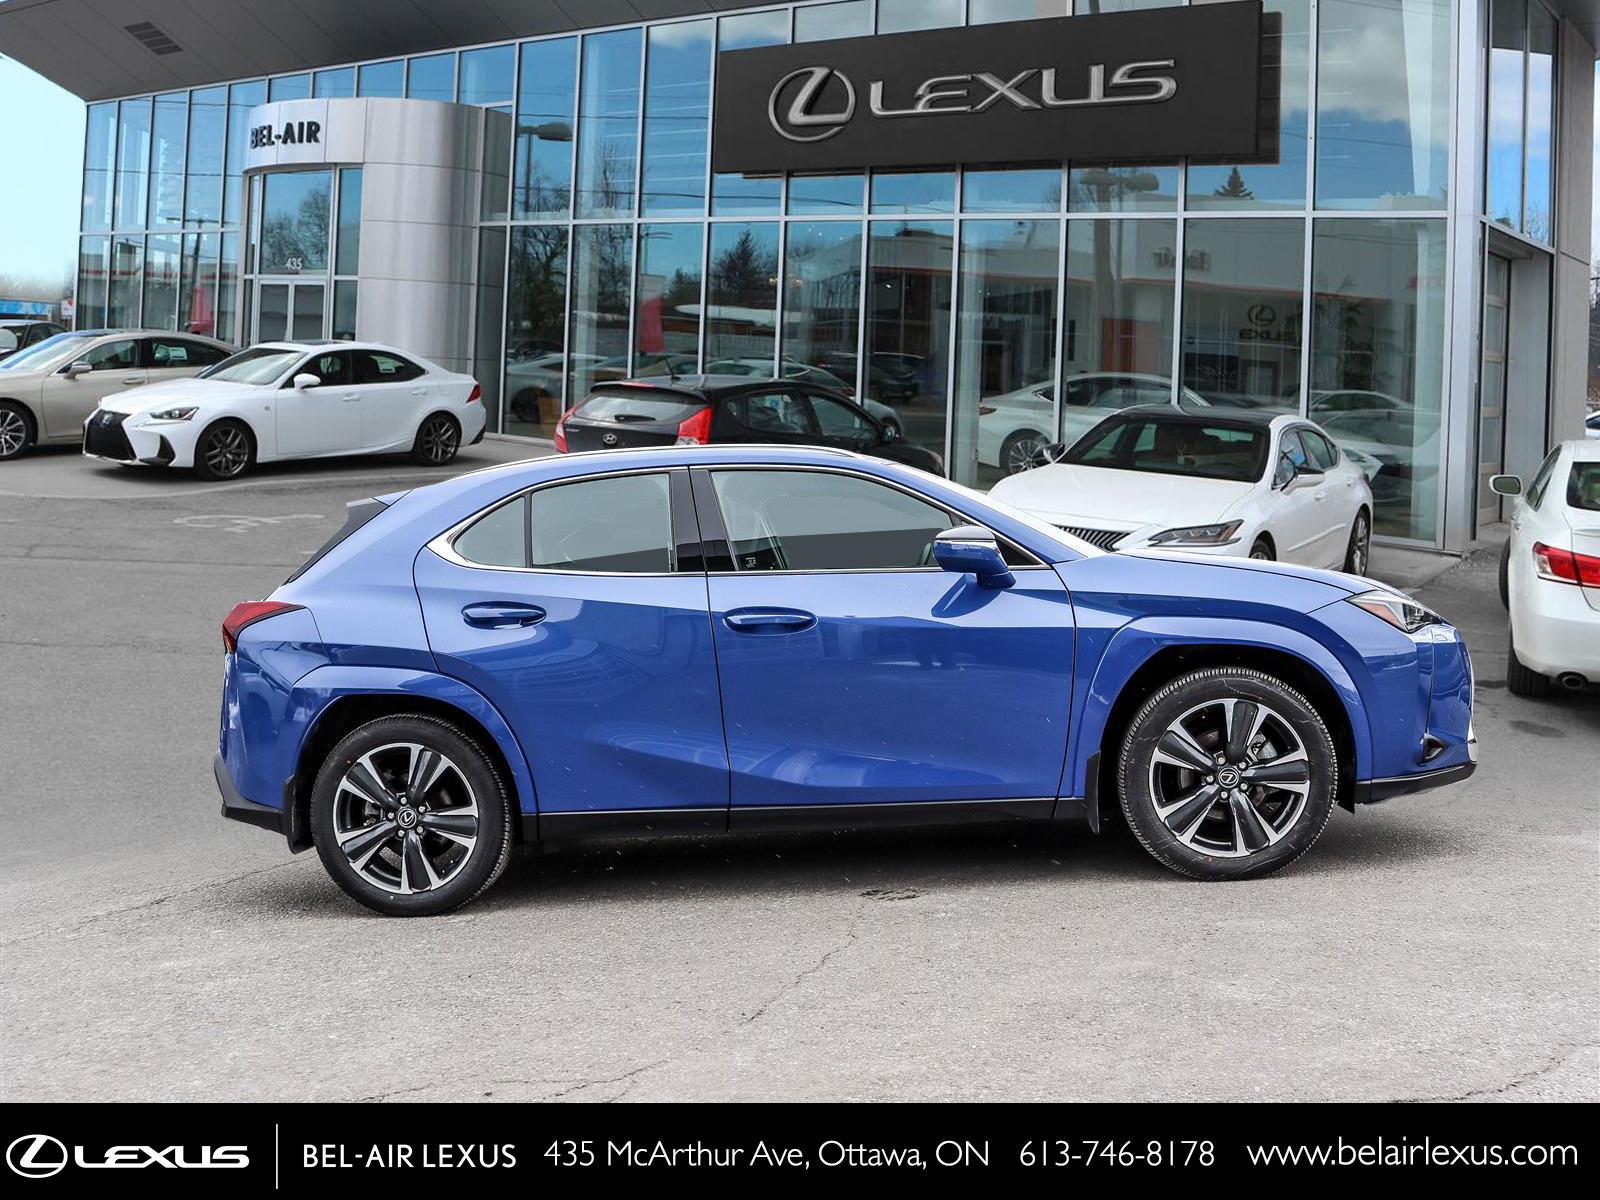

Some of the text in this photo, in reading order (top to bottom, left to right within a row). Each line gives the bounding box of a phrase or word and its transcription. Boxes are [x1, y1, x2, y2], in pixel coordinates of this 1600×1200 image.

[869, 58, 1178, 118] LEXUS
[250, 121, 321, 149] BEL-AIR
[286, 257, 303, 270] 435
